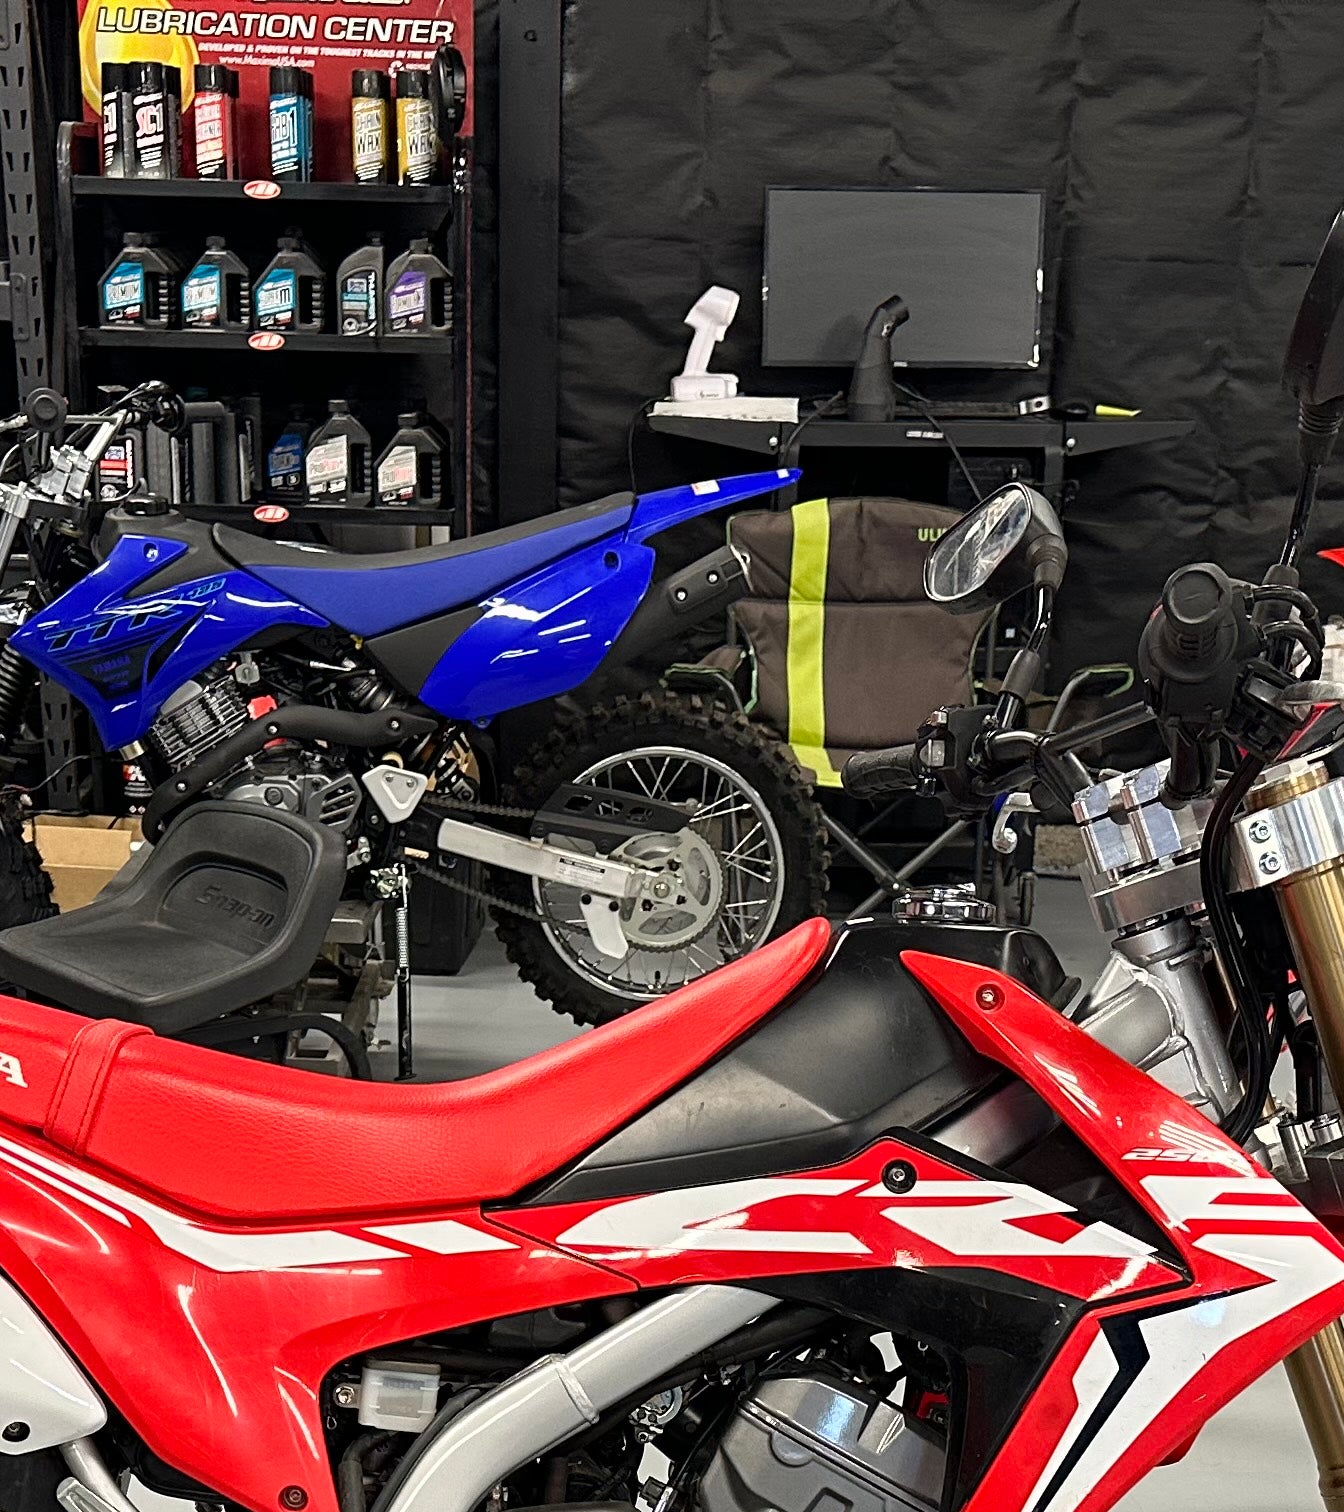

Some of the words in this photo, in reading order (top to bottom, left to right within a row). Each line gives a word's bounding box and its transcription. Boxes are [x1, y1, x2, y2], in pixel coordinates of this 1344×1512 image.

[97, 7, 317, 39] LUBRICATION
[323, 16, 454, 44] CENTER
[357, 131, 382, 154] WAX
[196, 884, 276, 929] Snap-on
